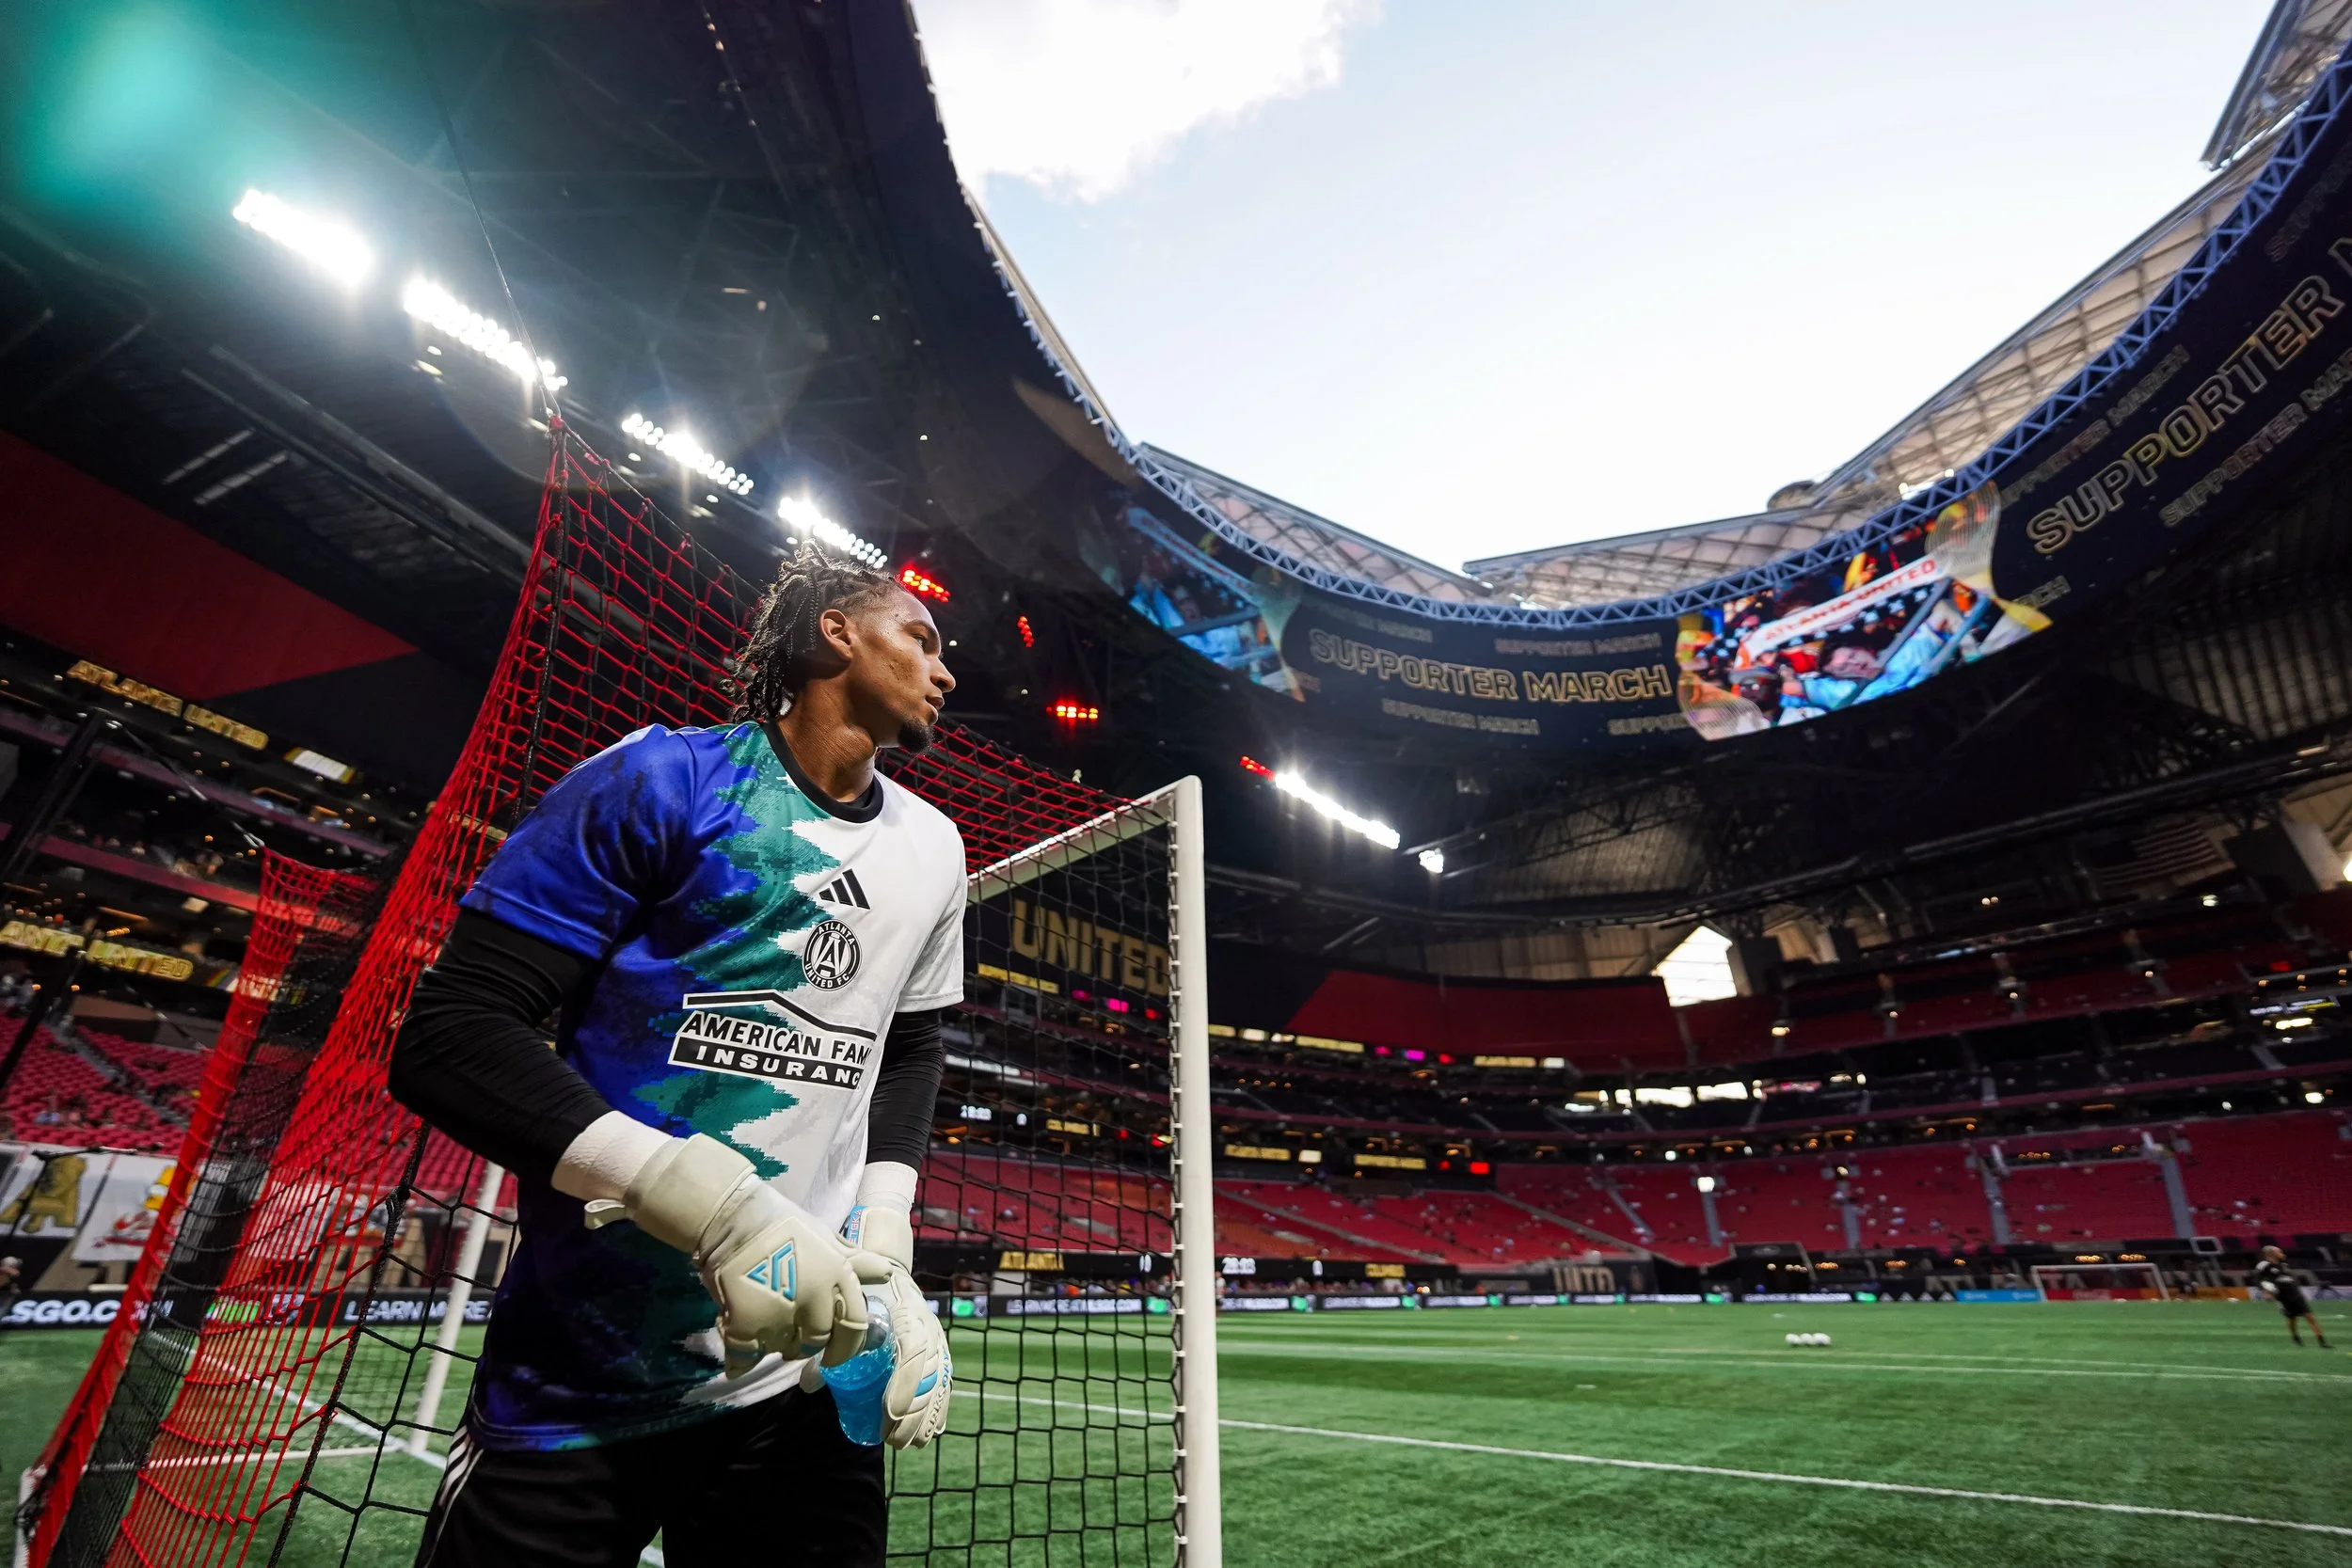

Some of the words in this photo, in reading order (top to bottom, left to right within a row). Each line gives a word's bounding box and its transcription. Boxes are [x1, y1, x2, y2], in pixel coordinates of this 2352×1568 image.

[2026, 274, 2346, 555] SUPPORTER
[2158, 402, 2309, 529] SUPPORTER
[1308, 627, 1519, 702] SUPPORTER
[1521, 662, 1674, 704] MARCH
[818, 922, 856, 945] ATLANTA
[1011, 898, 1170, 998] UNITED
[804, 962, 834, 989] UNITED
[836, 972, 850, 986] FC
[681, 1012, 822, 1058] AMERICAN
[343, 1300, 423, 1321] LEARN
[427, 1300, 490, 1321] MRE
